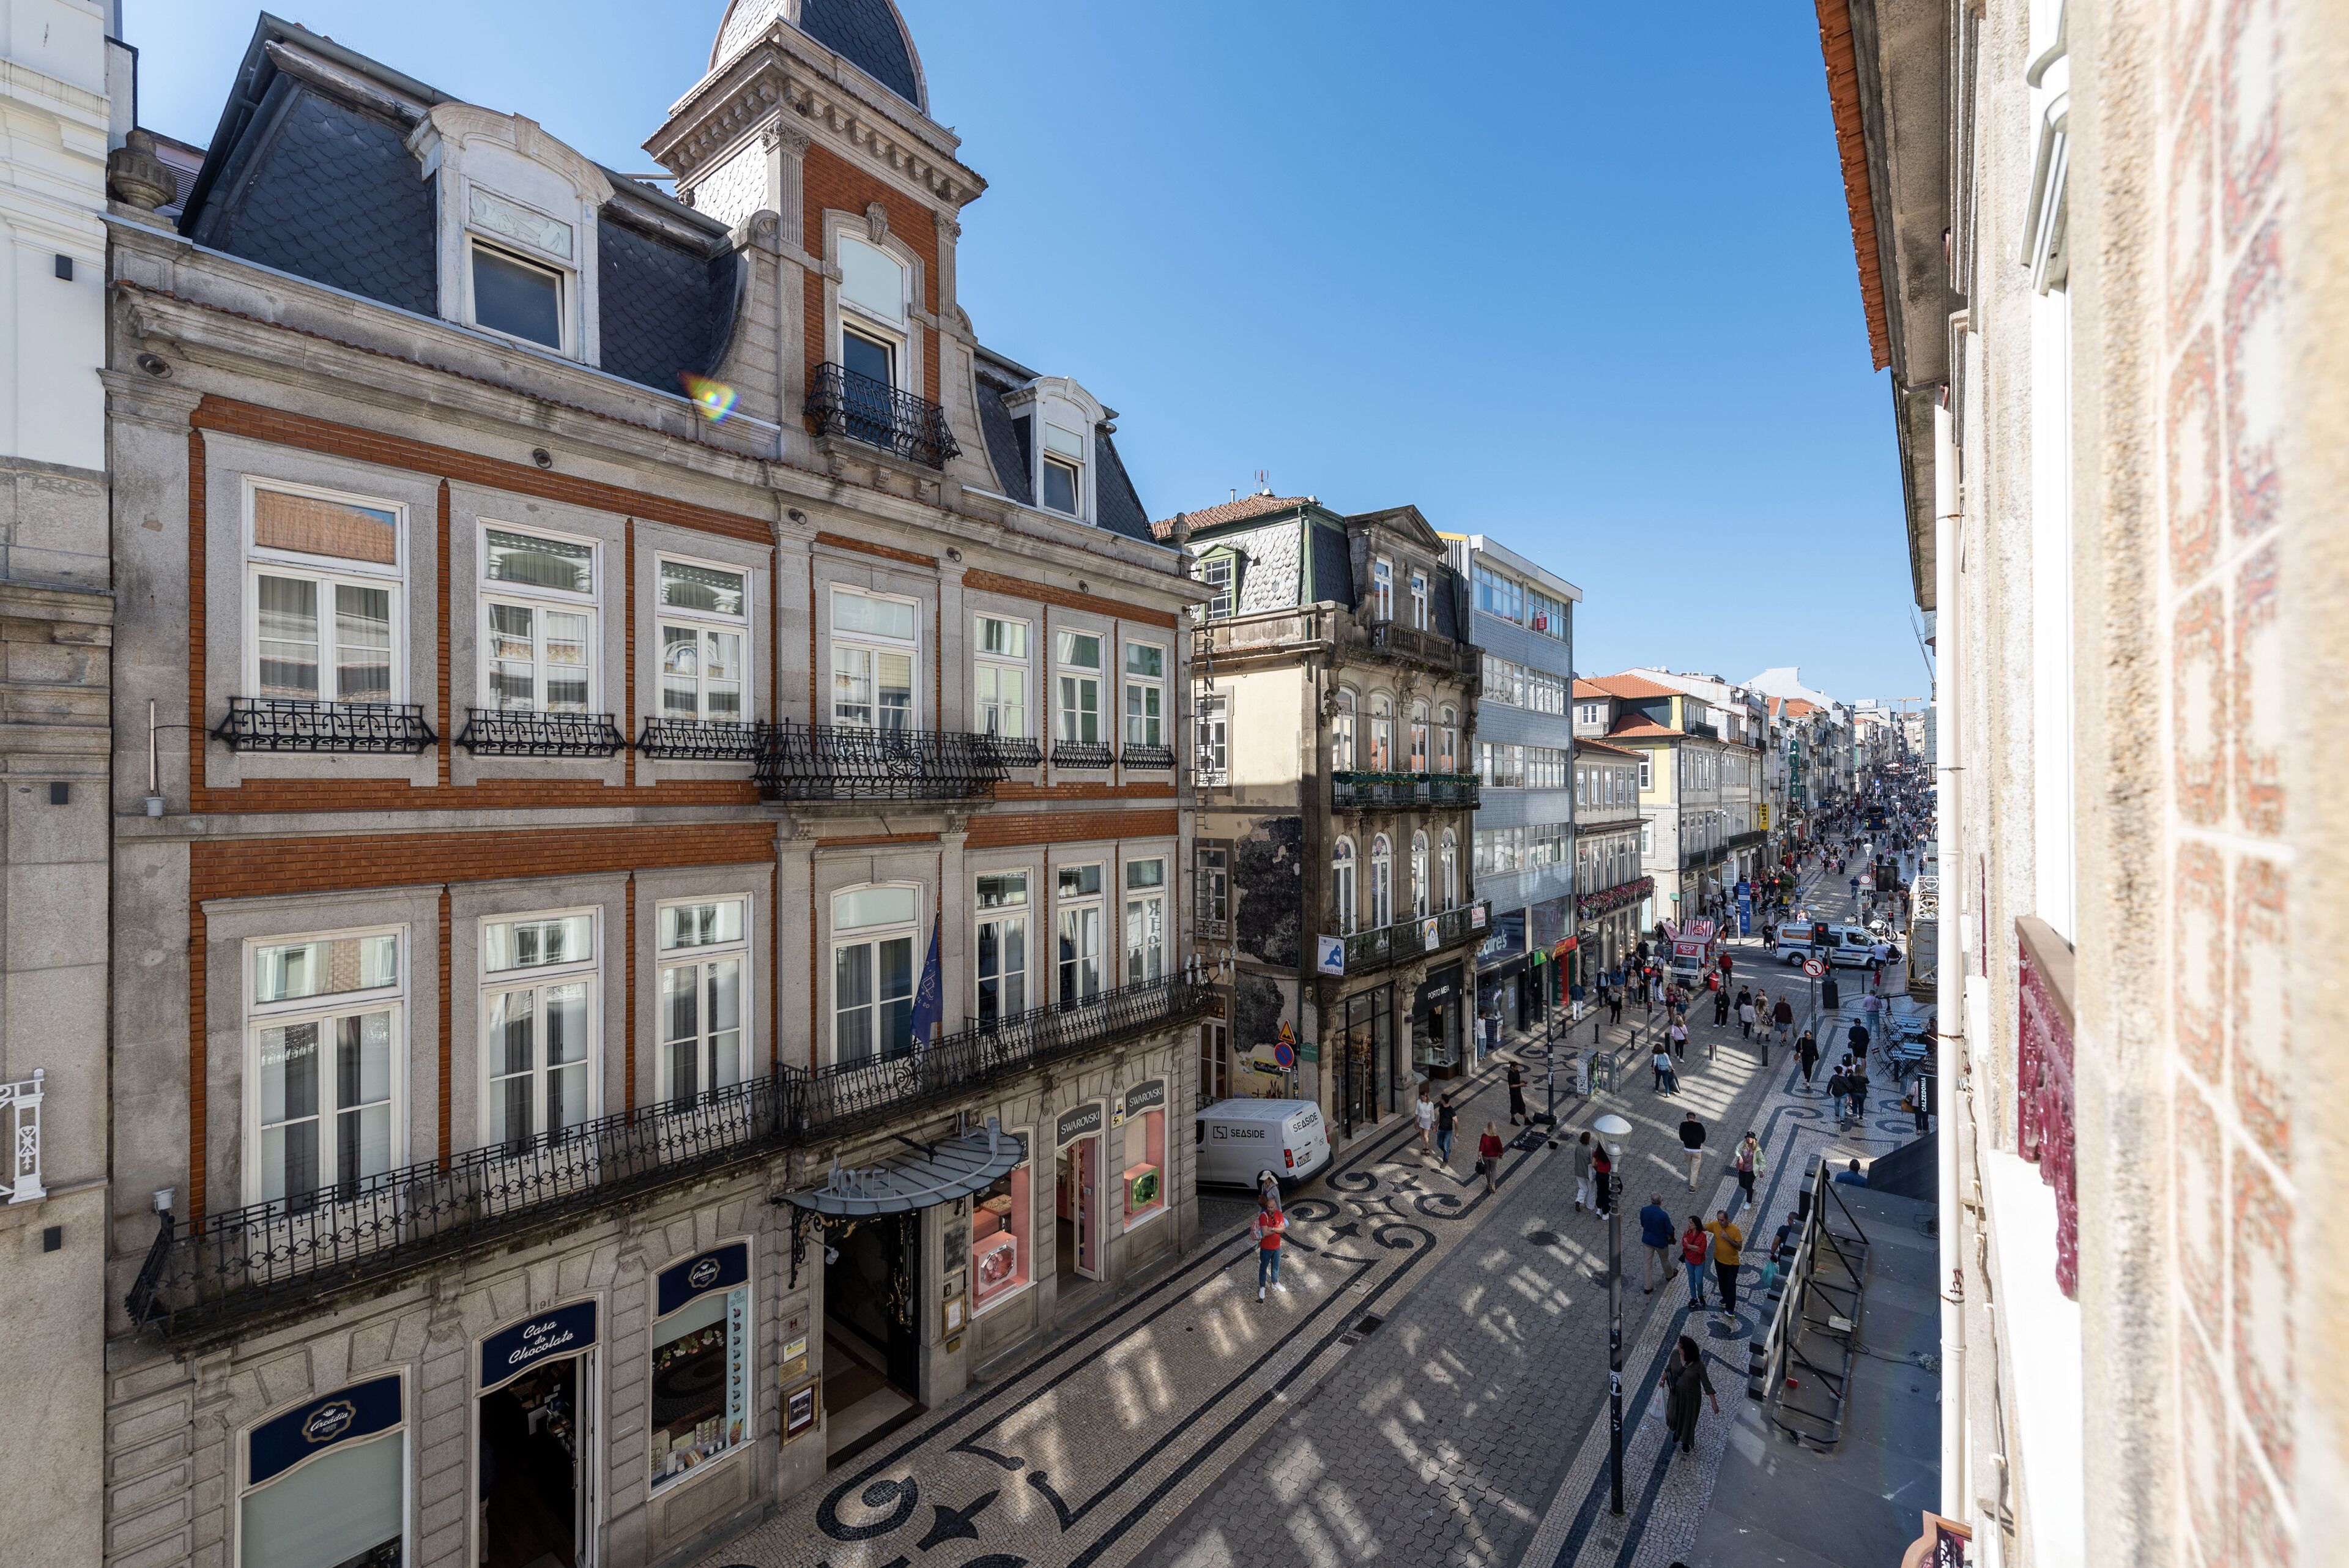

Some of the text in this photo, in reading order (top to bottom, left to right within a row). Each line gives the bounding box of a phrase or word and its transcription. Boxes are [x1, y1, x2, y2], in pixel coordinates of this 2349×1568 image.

[1204, 620, 1214, 729] GRANDE
[1204, 739, 1215, 830] HOTEL
[1205, 868, 1215, 959] PORTO
[1427, 988, 1441, 1000] PORTO
[1129, 1087, 1163, 1107] SWAROVSKI
[1061, 1111, 1100, 1135] SWAROVSKI
[1293, 1112, 1318, 1132] SEASIDE
[1231, 1128, 1265, 1139] SEASIDE
[828, 1168, 893, 1191] HOTEL
[523, 1321, 557, 1339] Casa
[534, 1335, 546, 1345] do
[508, 1329, 574, 1364] Chocolate
[310, 1412, 349, 1432] Arcádia
